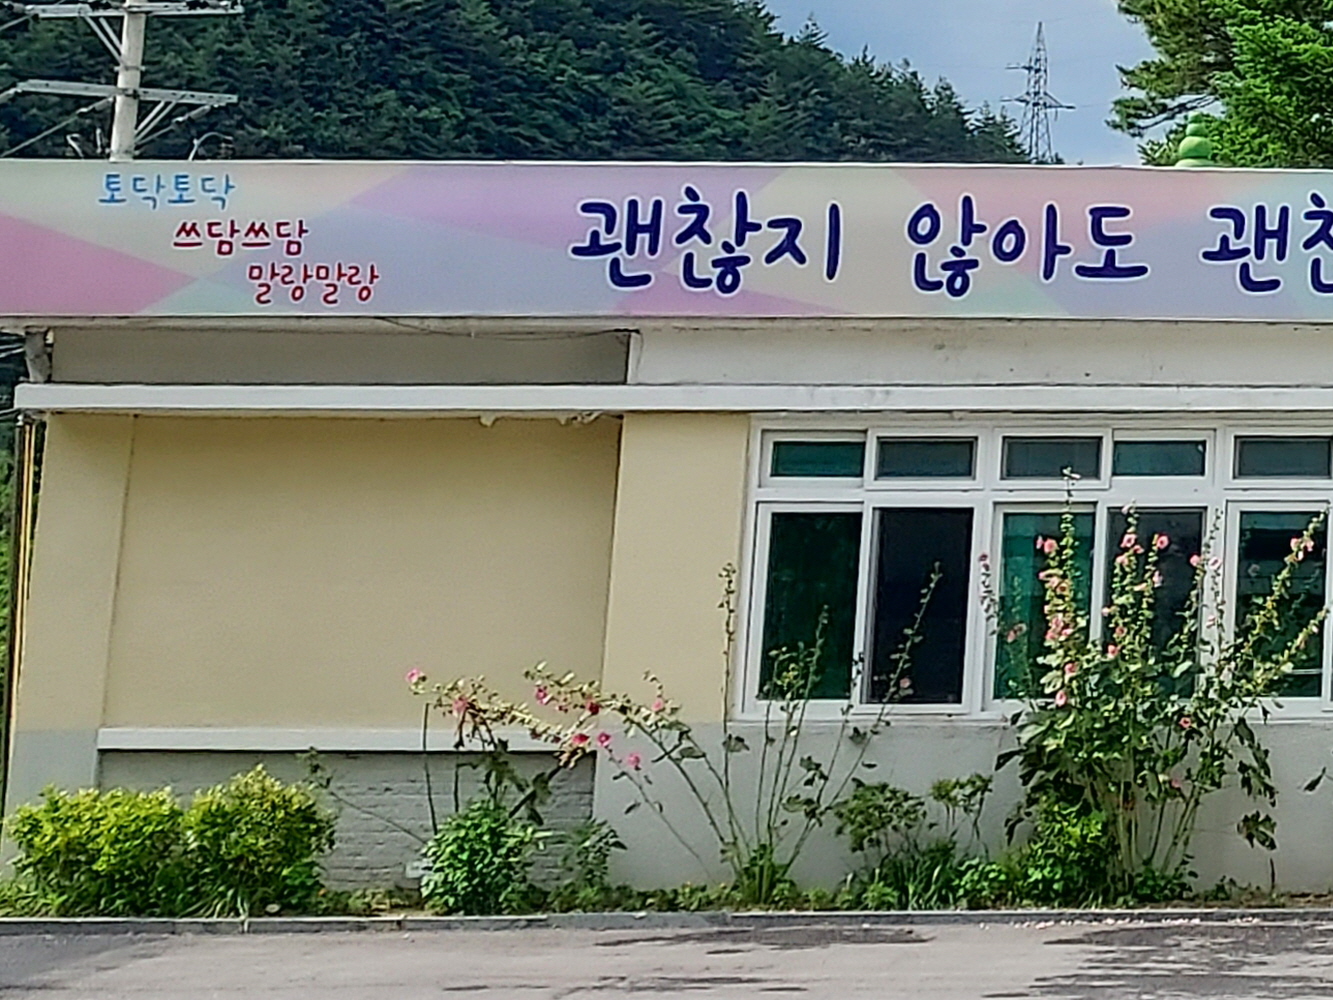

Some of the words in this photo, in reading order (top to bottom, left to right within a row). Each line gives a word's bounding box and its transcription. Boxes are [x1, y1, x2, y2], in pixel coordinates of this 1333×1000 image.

[99, 172, 236, 206] 토닥토닥
[174, 221, 309, 256] 쓰담쓰담
[571, 186, 841, 295] 괜찮지
[907, 195, 1149, 298] 않아도
[248, 264, 379, 304] 말랑말랑
